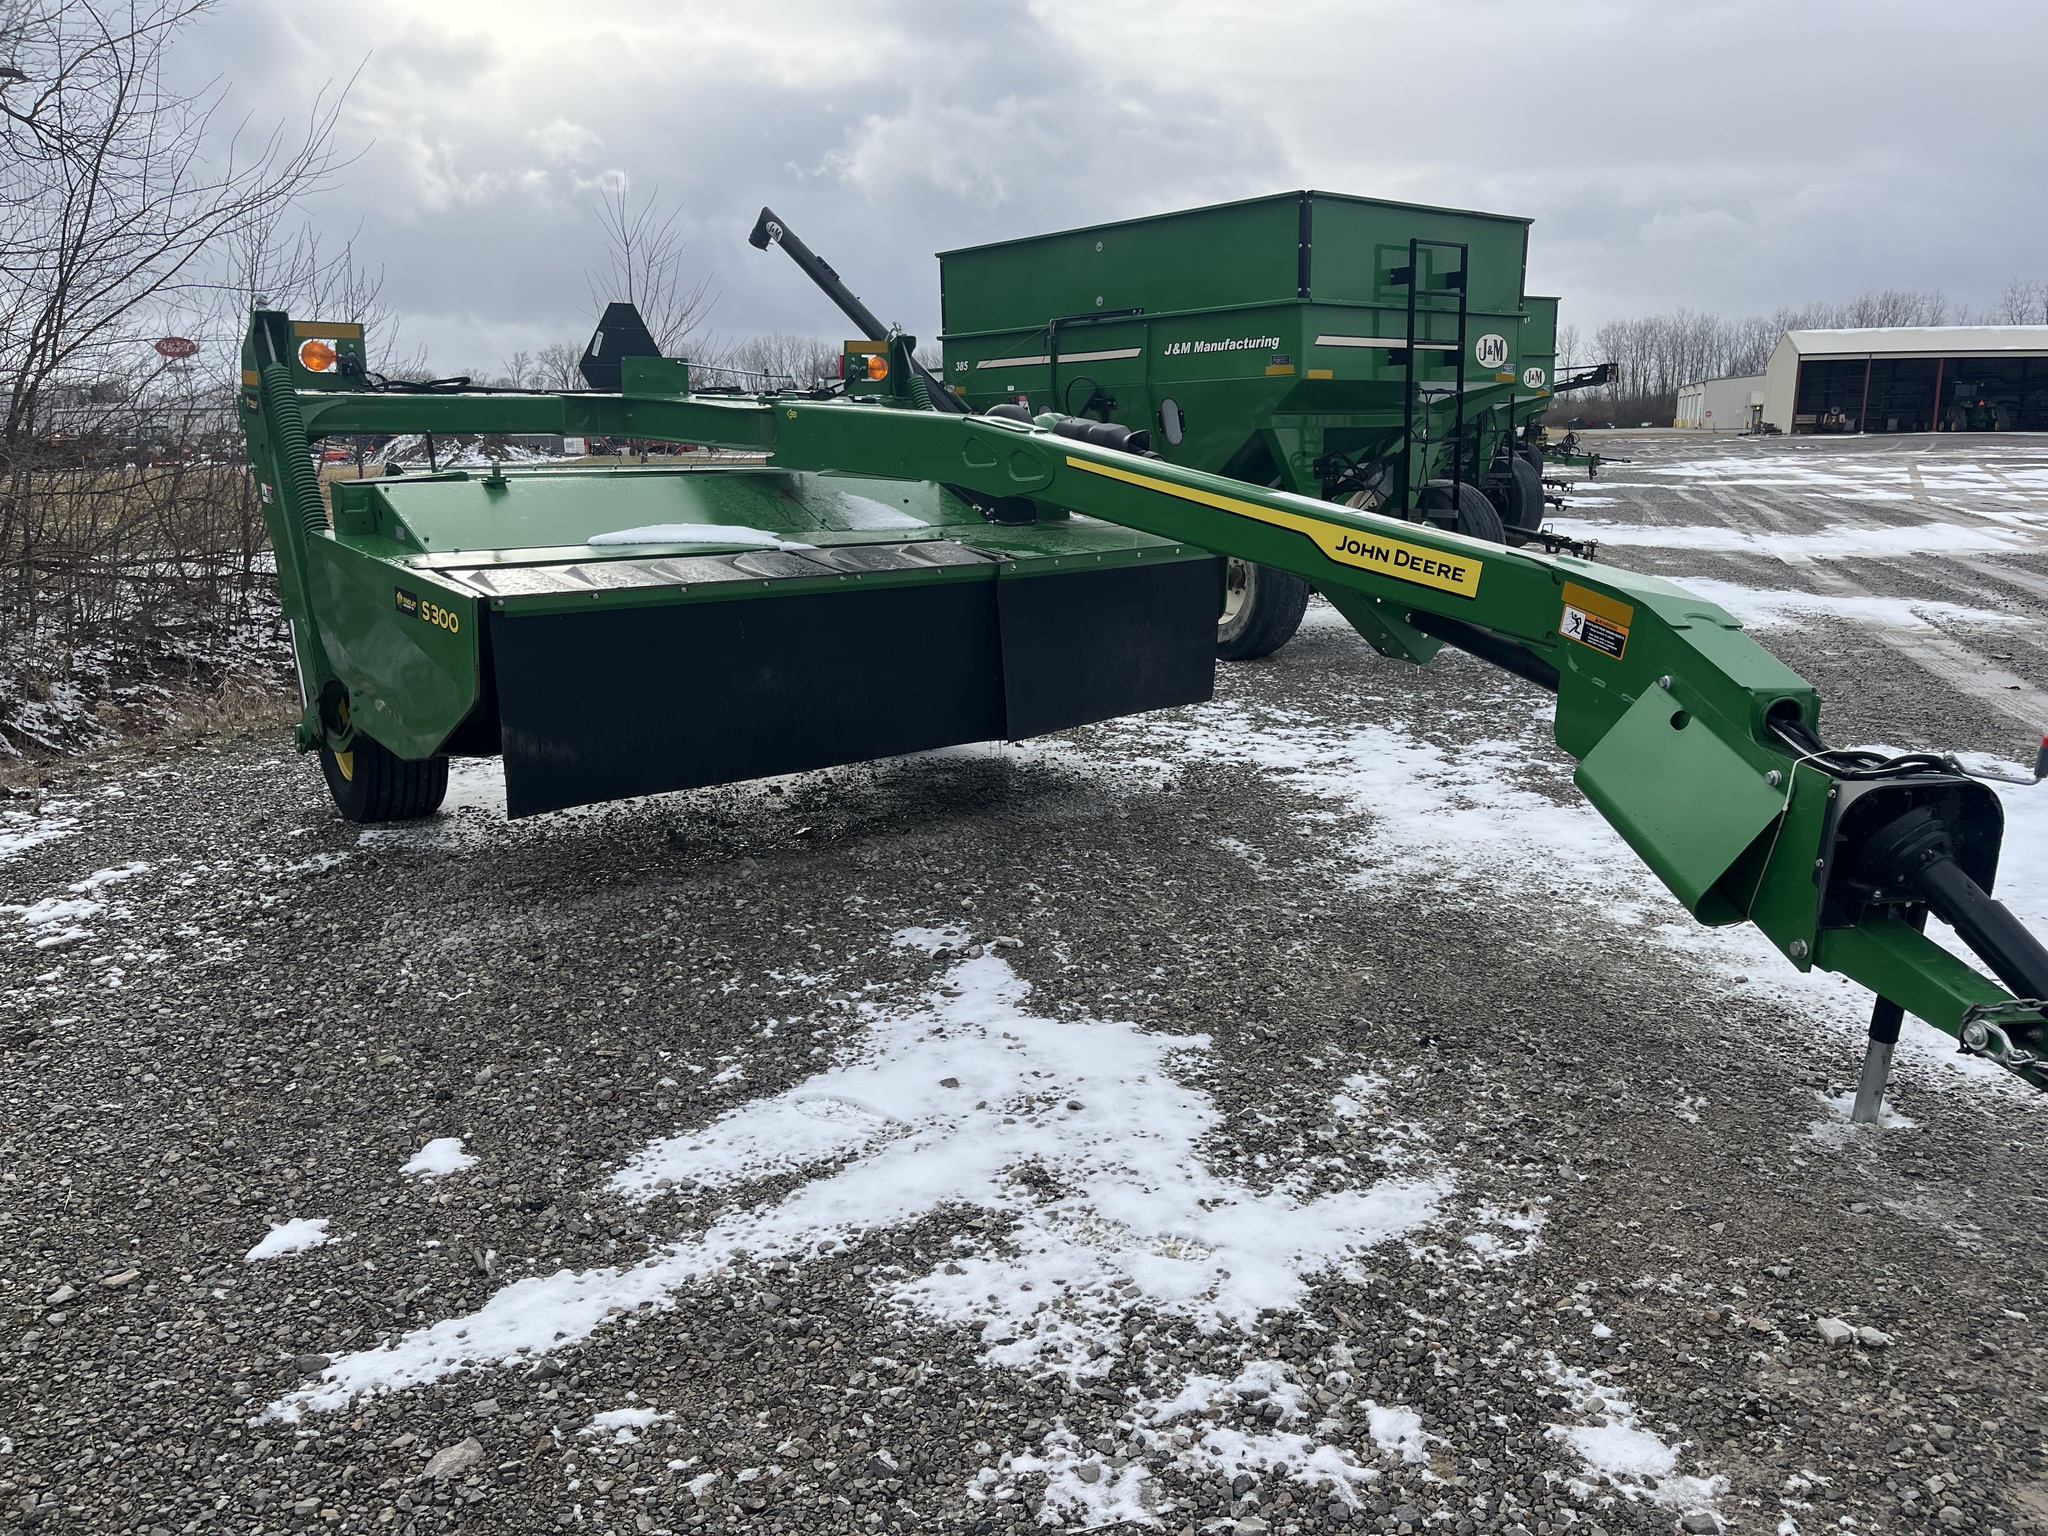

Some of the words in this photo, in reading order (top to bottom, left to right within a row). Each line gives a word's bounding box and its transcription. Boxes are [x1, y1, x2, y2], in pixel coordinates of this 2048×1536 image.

[1164, 342, 1191, 356] J&M
[1194, 335, 1280, 350] Manufacturing
[1478, 339, 1504, 361] J&M
[955, 361, 969, 372] 385
[1525, 370, 1543, 384] J&M
[1335, 535, 1390, 563] JOHN
[1393, 548, 1466, 583] DEERE
[421, 600, 459, 633] S300
